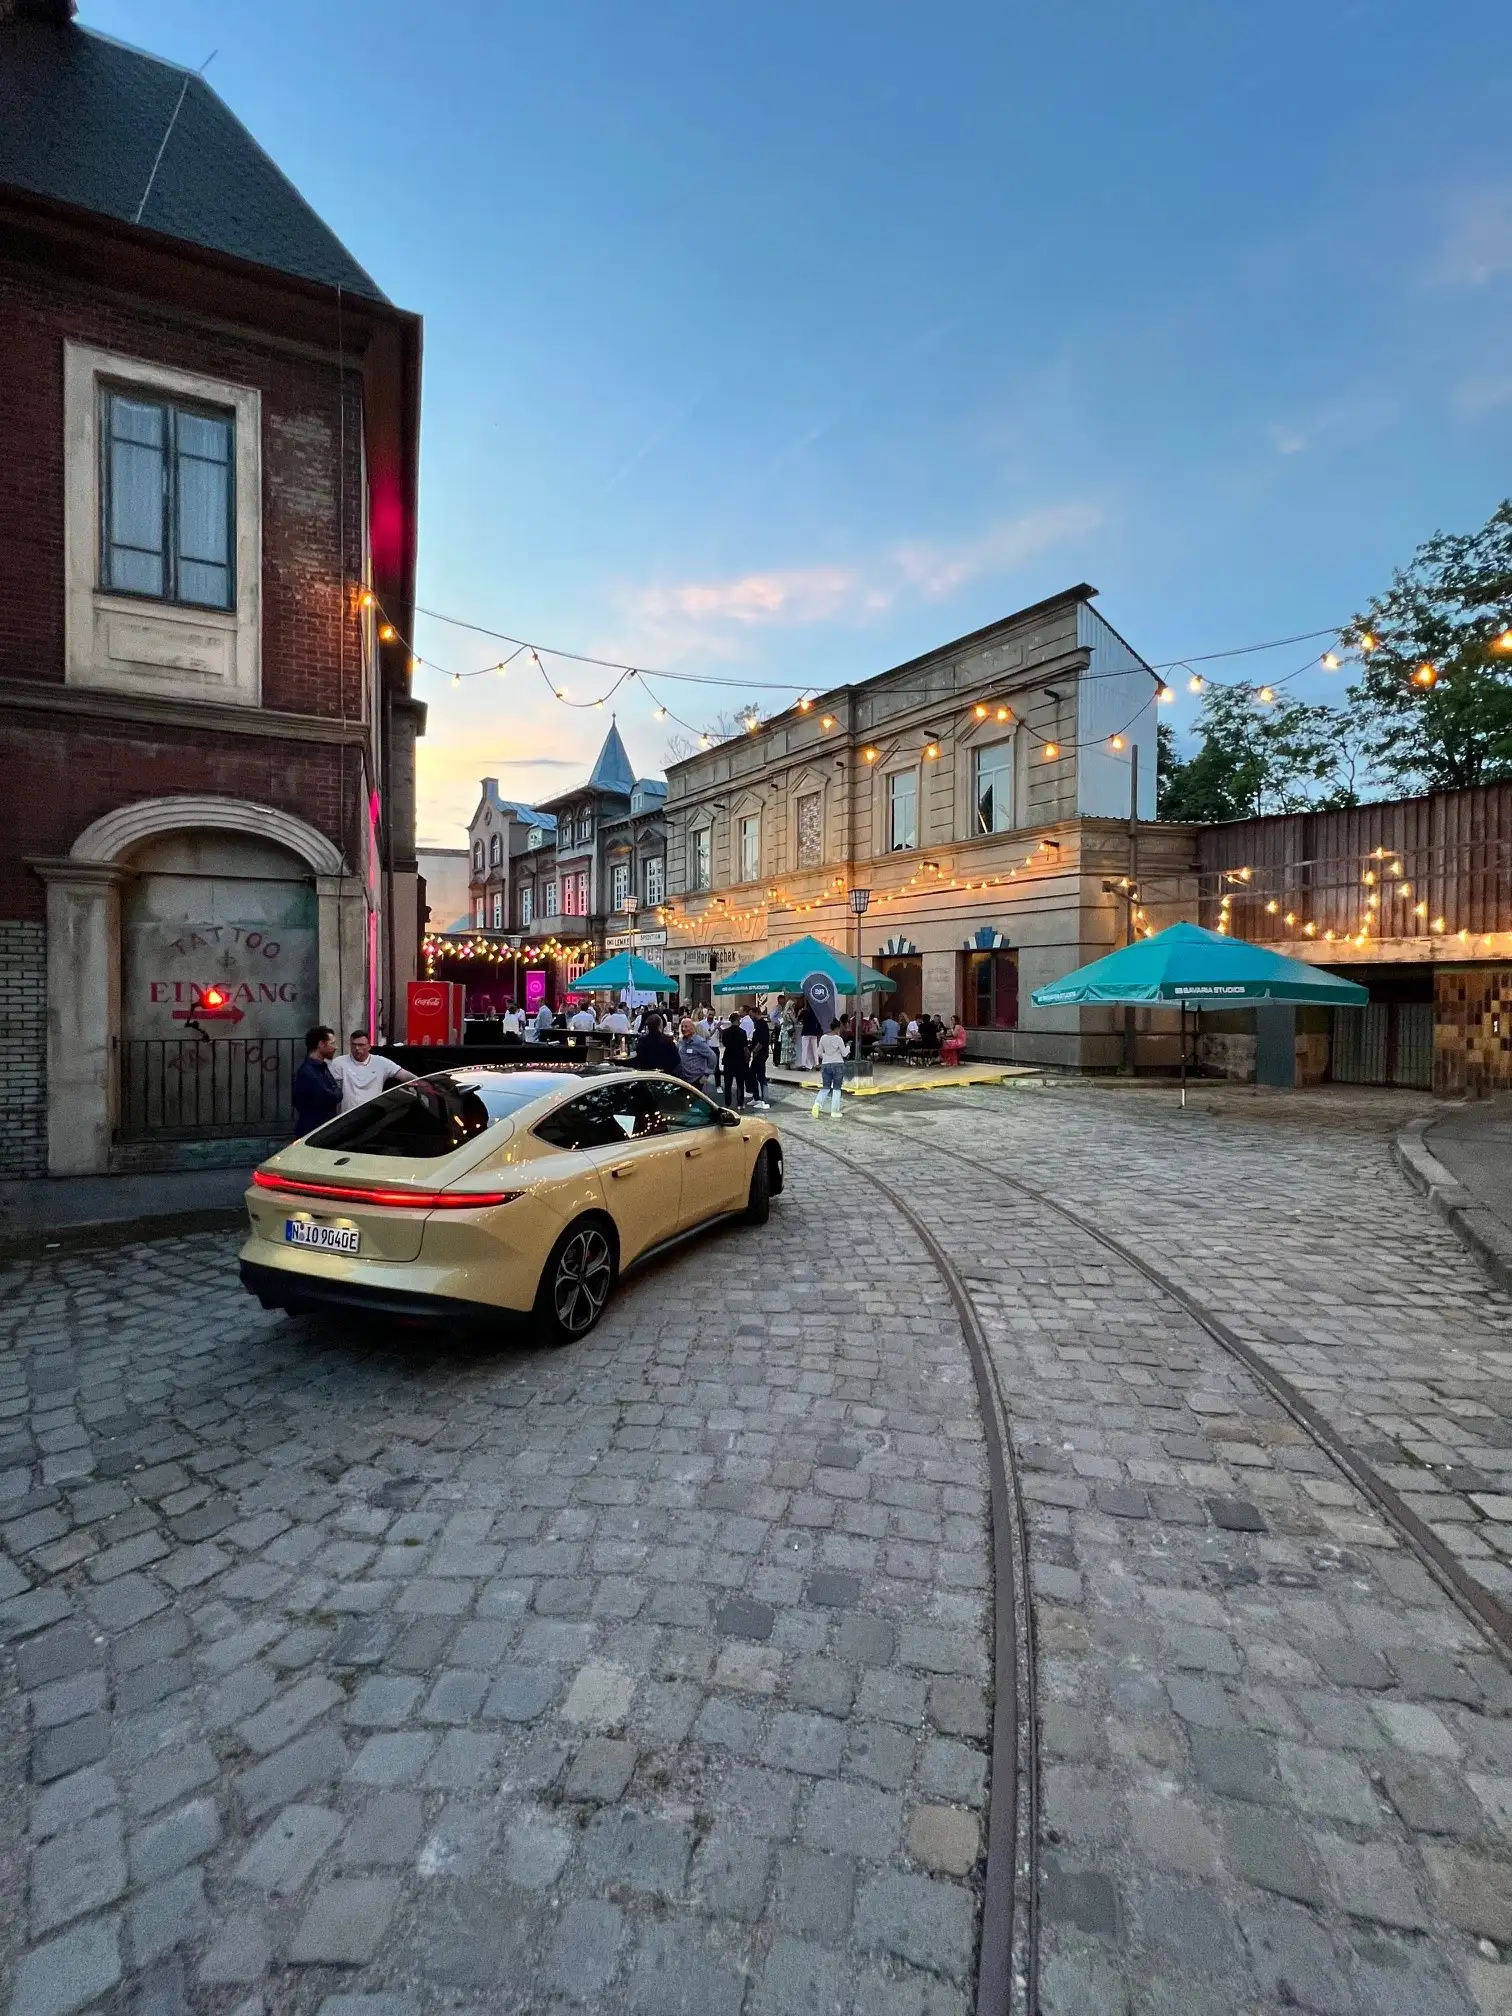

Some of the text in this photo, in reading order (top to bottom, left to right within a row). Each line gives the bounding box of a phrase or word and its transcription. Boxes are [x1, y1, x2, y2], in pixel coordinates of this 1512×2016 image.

[169, 926, 281, 959] TATTOO
[1213, 986, 1245, 994] STUDIOS
[414, 997, 441, 1006] Coca-Cola
[292, 1224, 299, 1240] N
[321, 1229, 358, 1250] 9040E
